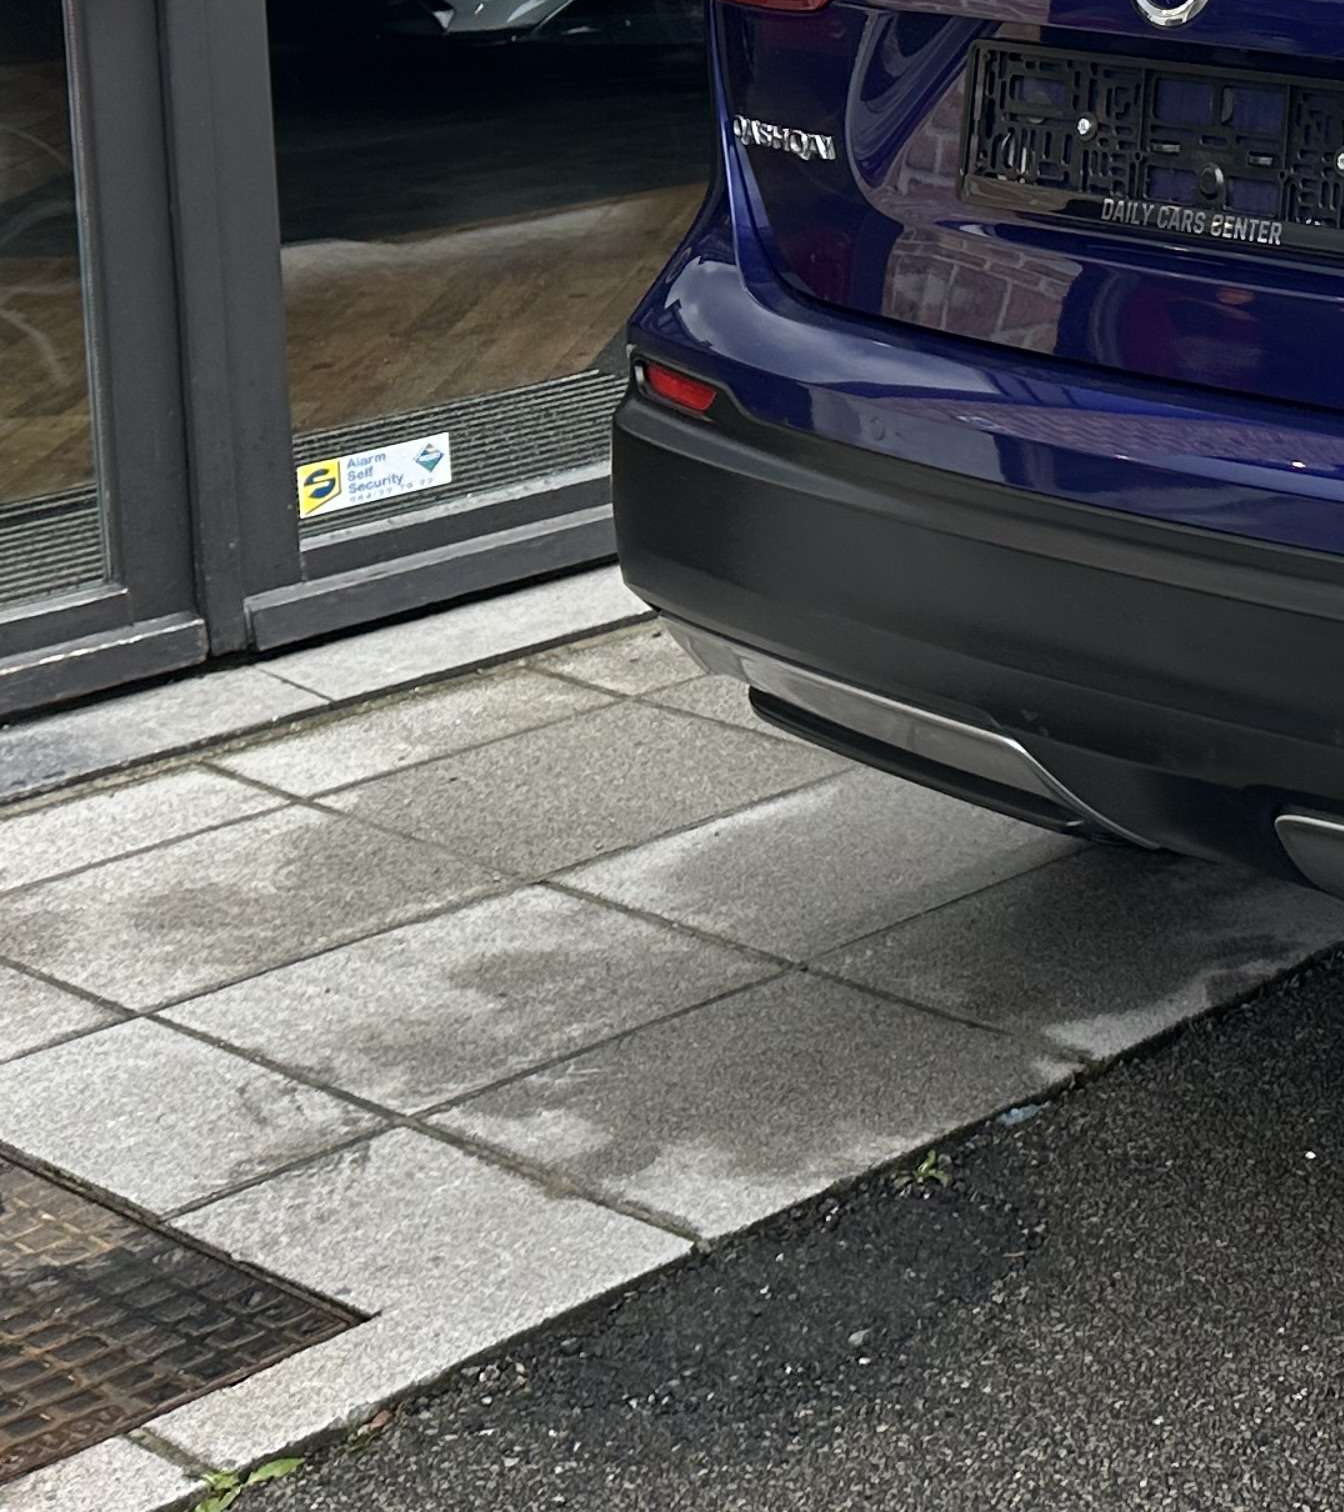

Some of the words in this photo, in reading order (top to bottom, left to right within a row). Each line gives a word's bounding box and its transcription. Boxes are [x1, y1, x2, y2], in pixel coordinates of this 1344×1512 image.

[1100, 197, 1155, 226] DAILY
[1156, 205, 1205, 235] CARS
[1211, 214, 1283, 246] CENTER
[347, 453, 386, 469] Alarm
[347, 466, 373, 482] Self
[348, 473, 404, 494] Security
